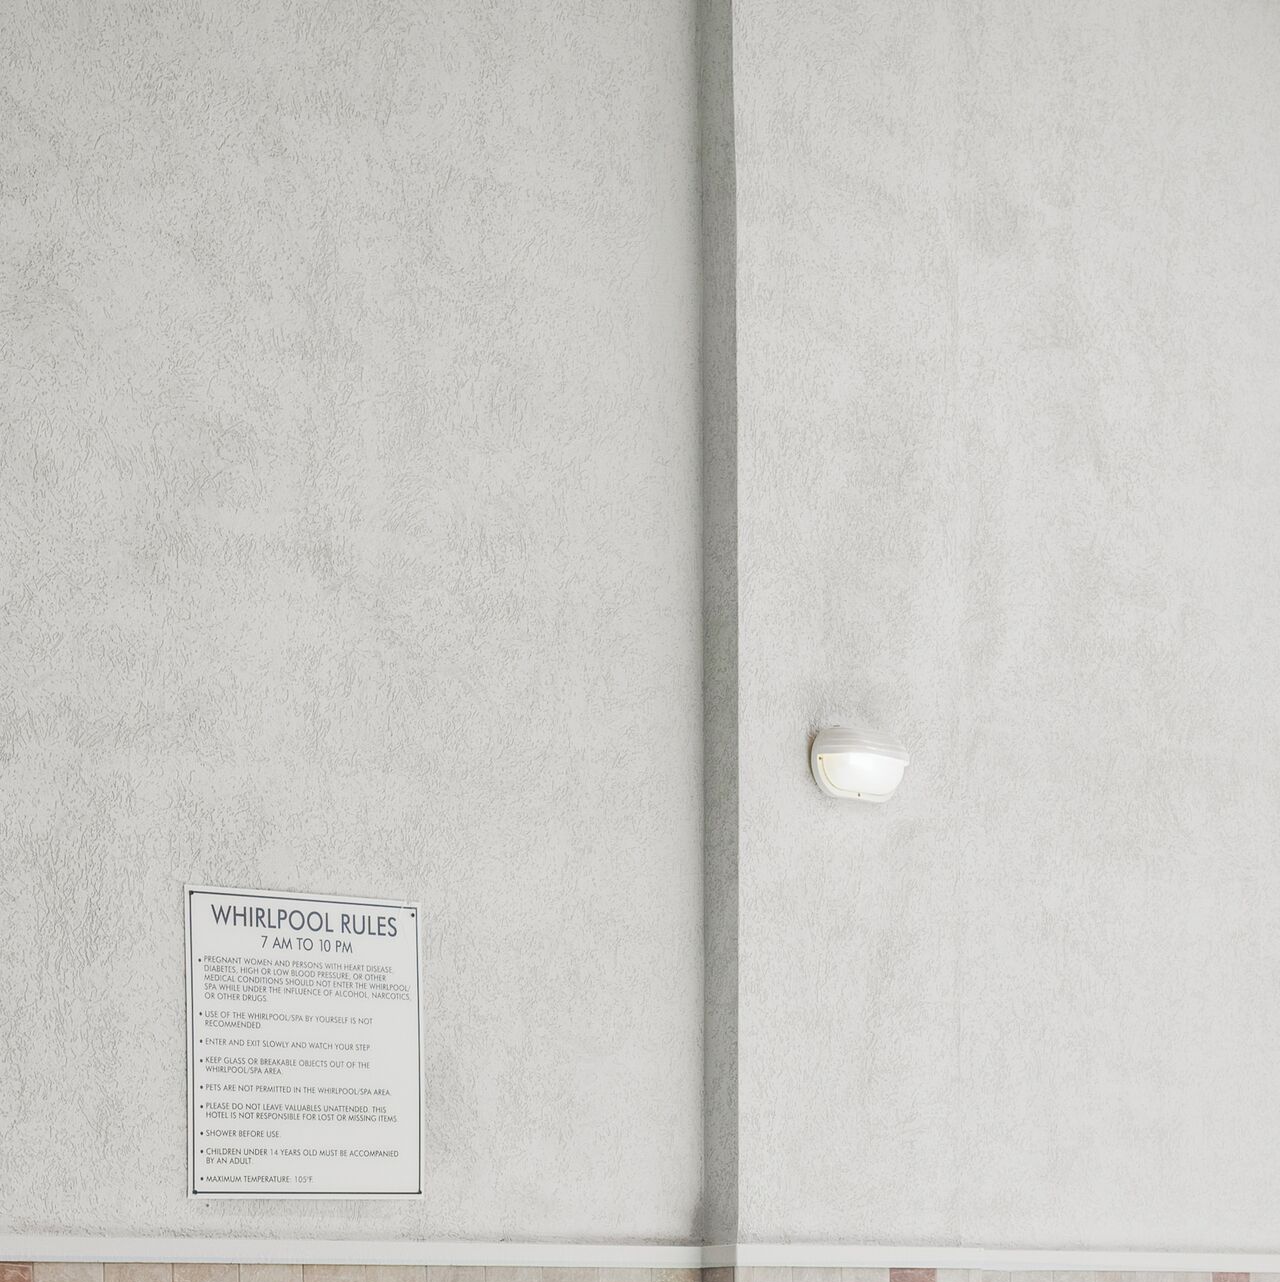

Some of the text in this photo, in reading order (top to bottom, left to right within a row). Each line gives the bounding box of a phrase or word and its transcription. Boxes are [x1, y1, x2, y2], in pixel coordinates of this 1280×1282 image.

[211, 904, 397, 937] WHIRLPOOL RULES
[261, 935, 353, 953] 7 AM TO 10 PM
[204, 955, 242, 964] PREGNANT
[244, 958, 273, 966] WOMEN
[292, 960, 323, 969] PERSONS
[324, 962, 342, 970] WITH
[344, 964, 364, 972] HEART
[261, 968, 271, 976] OR
[291, 970, 315, 978] BLOOD
[364, 973, 386, 982] OTHER
[204, 974, 235, 983] MEDICAL
[237, 975, 283, 985] CONDITIONS
[285, 978, 314, 987] SHOULD
[316, 980, 331, 988] NOT
[333, 981, 353, 989] ENTER
[355, 982, 367, 990] THE
[204, 983, 217, 991] SPA
[218, 984, 240, 992] WHILE
[242, 985, 267, 993] UNDER
[268, 986, 281, 994] THE
[283, 987, 321, 996] INFLUENCE
[323, 989, 333, 997] OF
[204, 992, 215, 1000] OR
[217, 993, 240, 1001] OTHER
[204, 1010, 218, 1018] USE
[220, 1011, 231, 1019] OF
[315, 1016, 348, 1024] YOURSELF
[358, 1017, 373, 1025] NOT
[205, 1038, 227, 1046] ENTER
[262, 1040, 289, 1048] SLOWLY
[291, 1041, 307, 1049] AND
[308, 1042, 332, 1050] WATCH
[334, 1043, 353, 1051] YOUR
[205, 1056, 222, 1064] KEEP
[223, 1057, 246, 1065] GLASS
[260, 1058, 297, 1067] BREAKABLE
[298, 1060, 327, 1068] OBJECTS
[223, 1084, 236, 1092] ARE
[255, 1085, 292, 1093] PERMITTED
[303, 1086, 316, 1094] THE
[205, 1102, 229, 1110] PLEASE
[245, 1103, 261, 1111] NOT
[284, 1104, 322, 1112] VALUABLES
[371, 1106, 387, 1114] THIS
[205, 1111, 229, 1119] HOTEL
[238, 1112, 254, 1120] NOT
[255, 1112, 300, 1120] RESPONSIBLE
[336, 1114, 347, 1122] OR
[347, 1114, 377, 1122] MISSING
[205, 1129, 237, 1137] SHOWER
[238, 1130, 264, 1138] BEFORE
[205, 1148, 242, 1156] CHILDREN
[243, 1148, 268, 1156] UNDER
[302, 1149, 318, 1157] OLD
[319, 1149, 338, 1157] MUST
[349, 1150, 399, 1158] ACCOMPANIED
[205, 1175, 242, 1183] MAXIMUM
